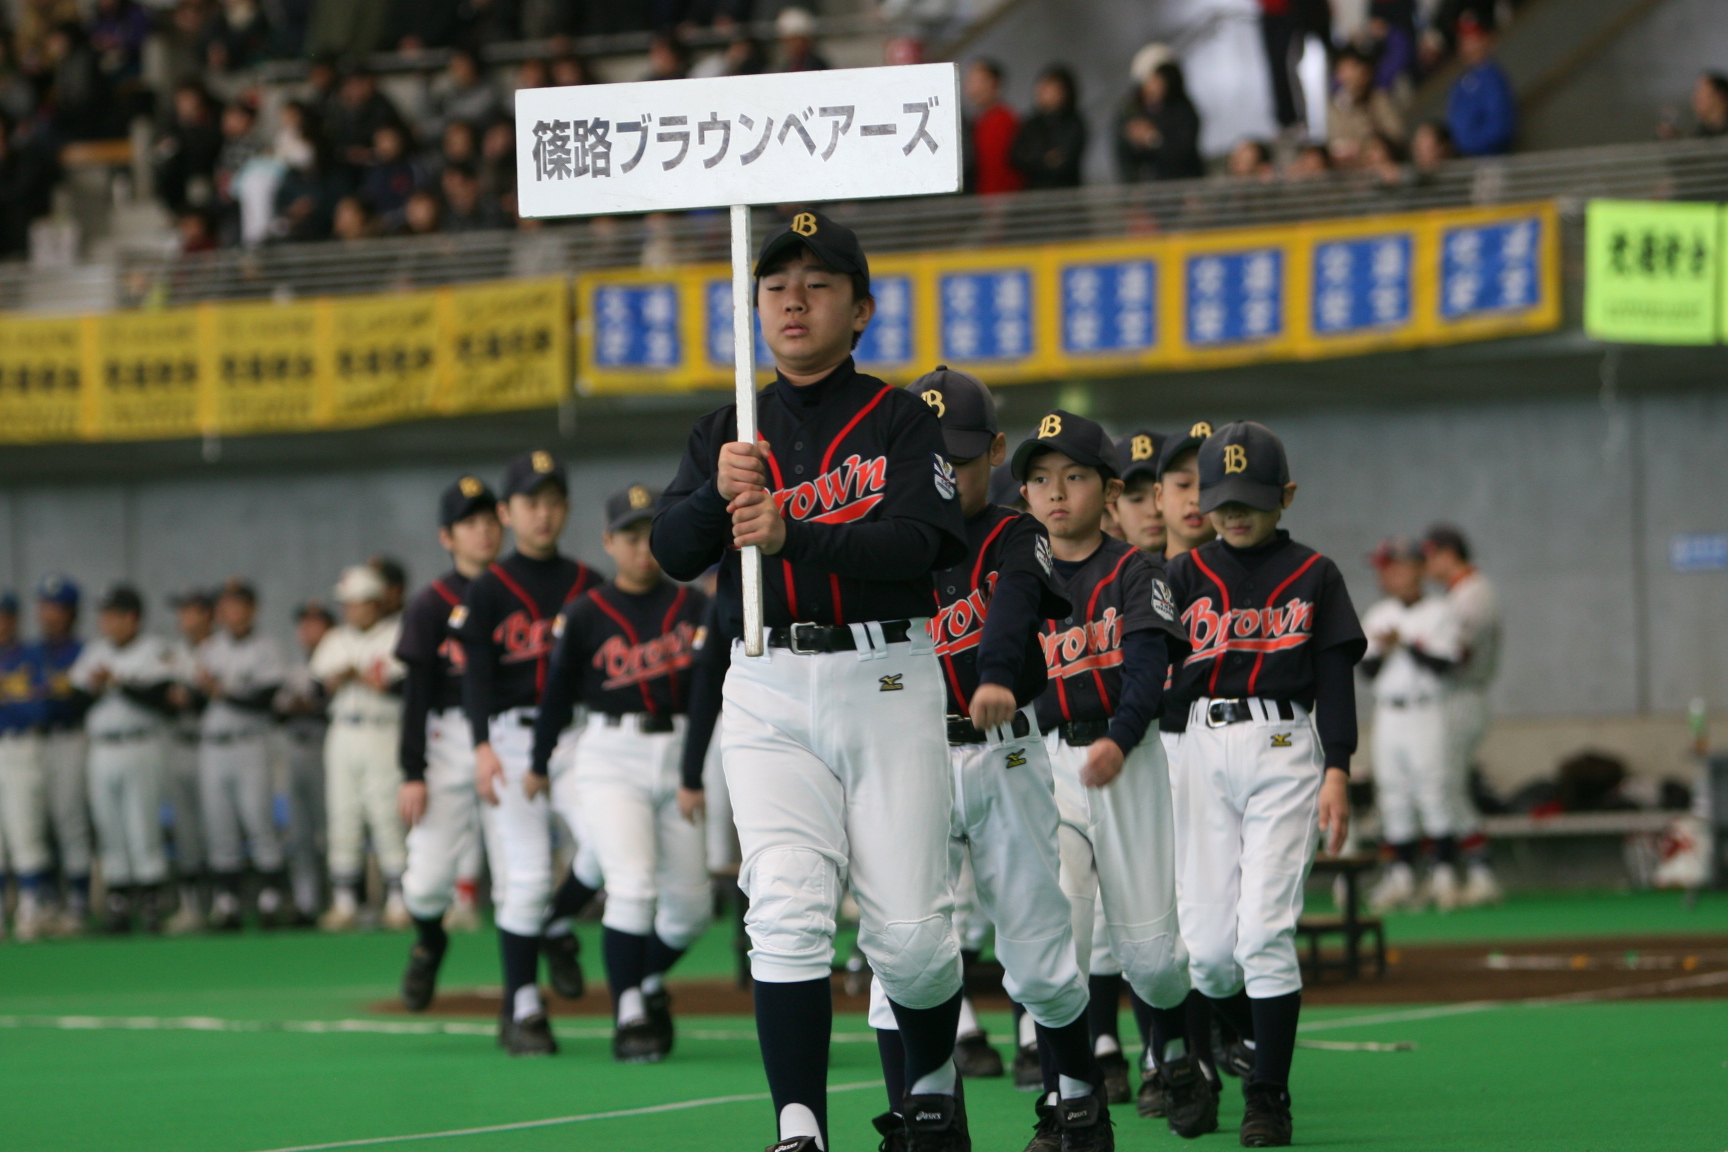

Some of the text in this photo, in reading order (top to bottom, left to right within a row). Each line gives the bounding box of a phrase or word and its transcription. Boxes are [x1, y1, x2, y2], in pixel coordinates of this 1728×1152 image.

[532, 95, 940, 182] 篠路ブラウンベアーズ
[791, 212, 818, 237] B
[921, 389, 946, 418] B
[1038, 413, 1062, 439] B
[1131, 434, 1154, 461] B
[1223, 444, 1248, 474] B
[761, 454, 887, 521] rown
[1038, 606, 1125, 668] row
[1180, 596, 1314, 653] Brown
